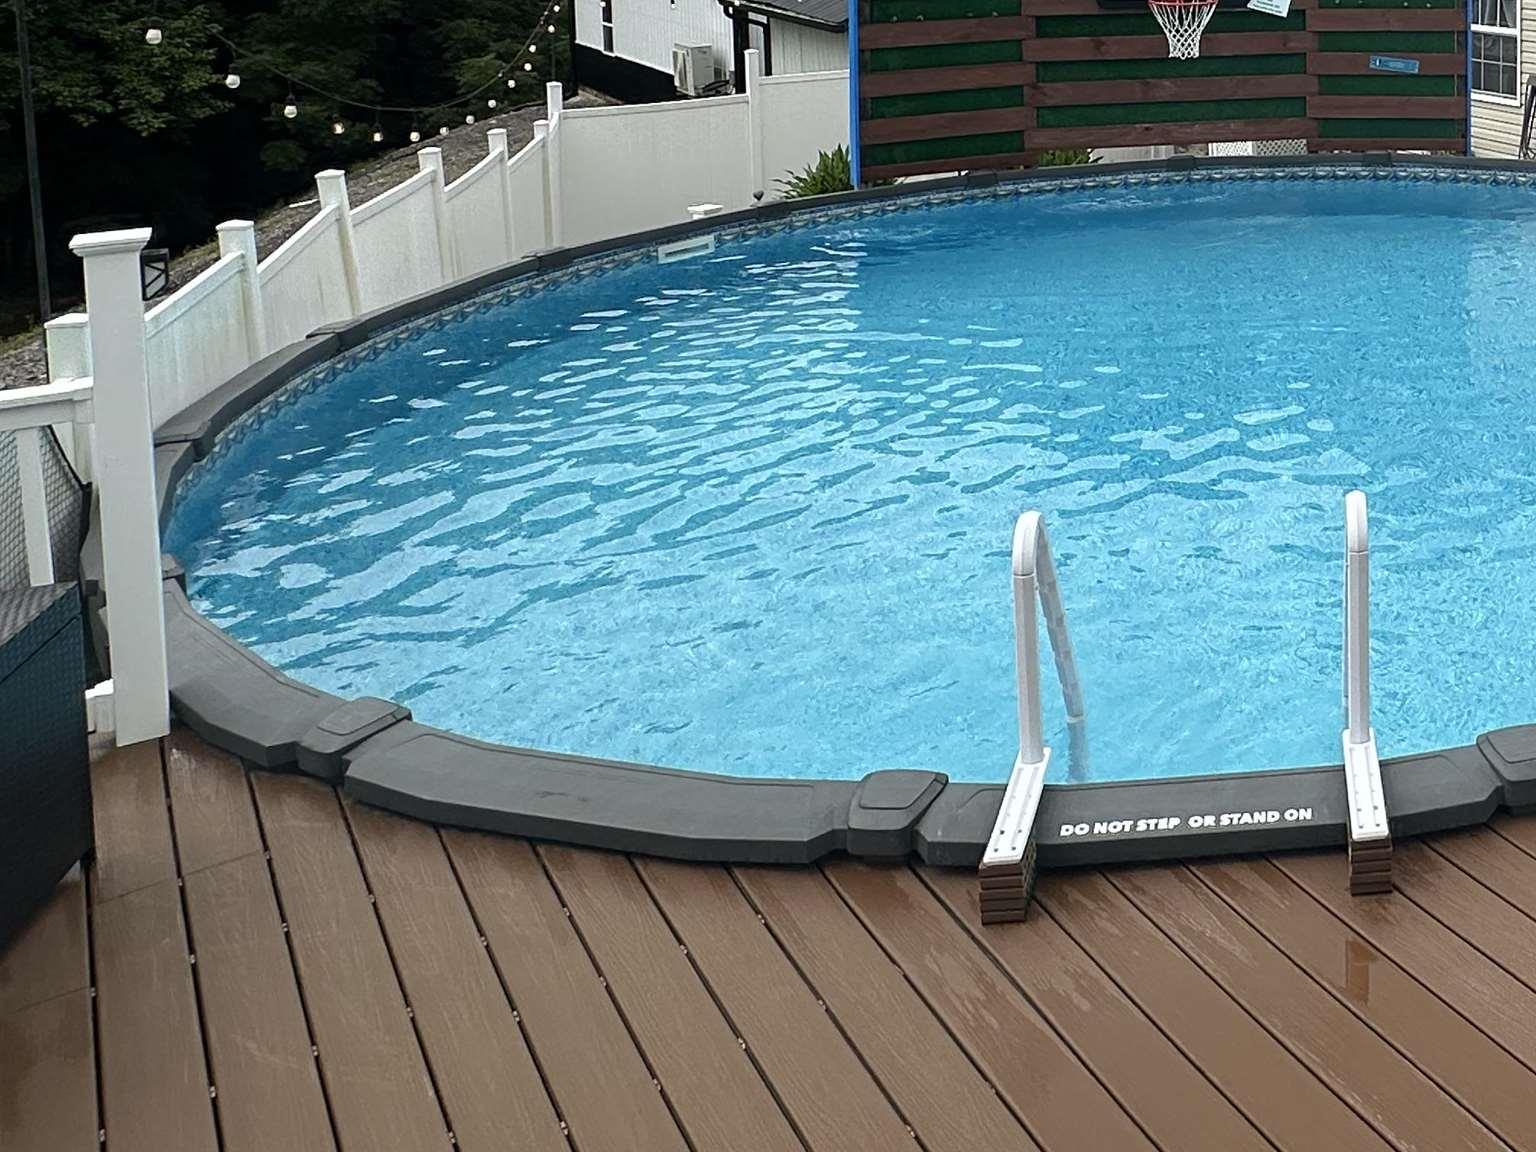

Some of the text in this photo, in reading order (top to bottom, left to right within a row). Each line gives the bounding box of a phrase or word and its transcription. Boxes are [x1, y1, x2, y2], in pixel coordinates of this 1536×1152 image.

[1059, 808, 1313, 837] DO NOT STEP OR STAND ON
